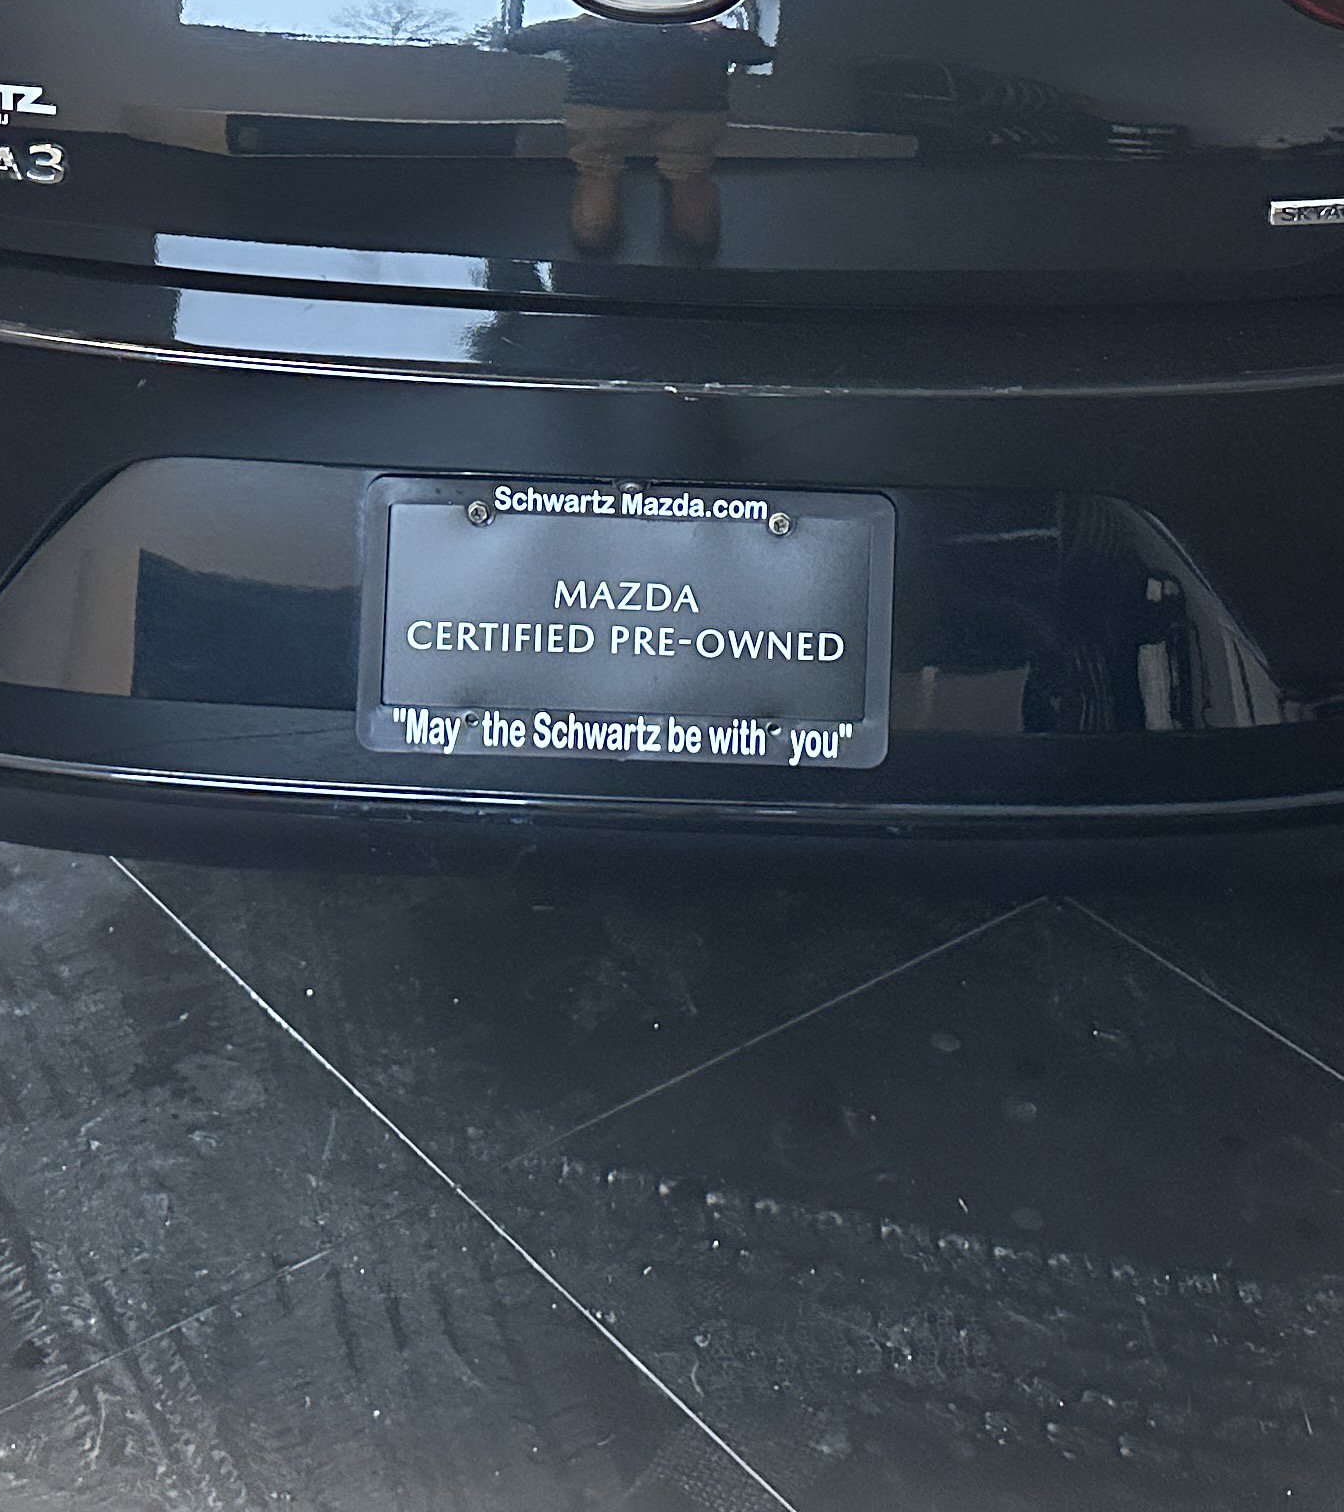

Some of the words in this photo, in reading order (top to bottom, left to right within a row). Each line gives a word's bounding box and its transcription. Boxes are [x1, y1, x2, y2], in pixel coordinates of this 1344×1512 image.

[493, 484, 616, 517] Schwartz
[620, 491, 769, 521] Mazda.com
[553, 579, 700, 614] MAZDA
[406, 619, 596, 655] CERTIFIED
[610, 625, 846, 663] PRE-OWNED
[391, 706, 462, 755] "May
[481, 709, 527, 748] the
[532, 710, 662, 753] Schwartz
[668, 715, 703, 754] be
[707, 717, 767, 757] with
[788, 721, 854, 767] you"
